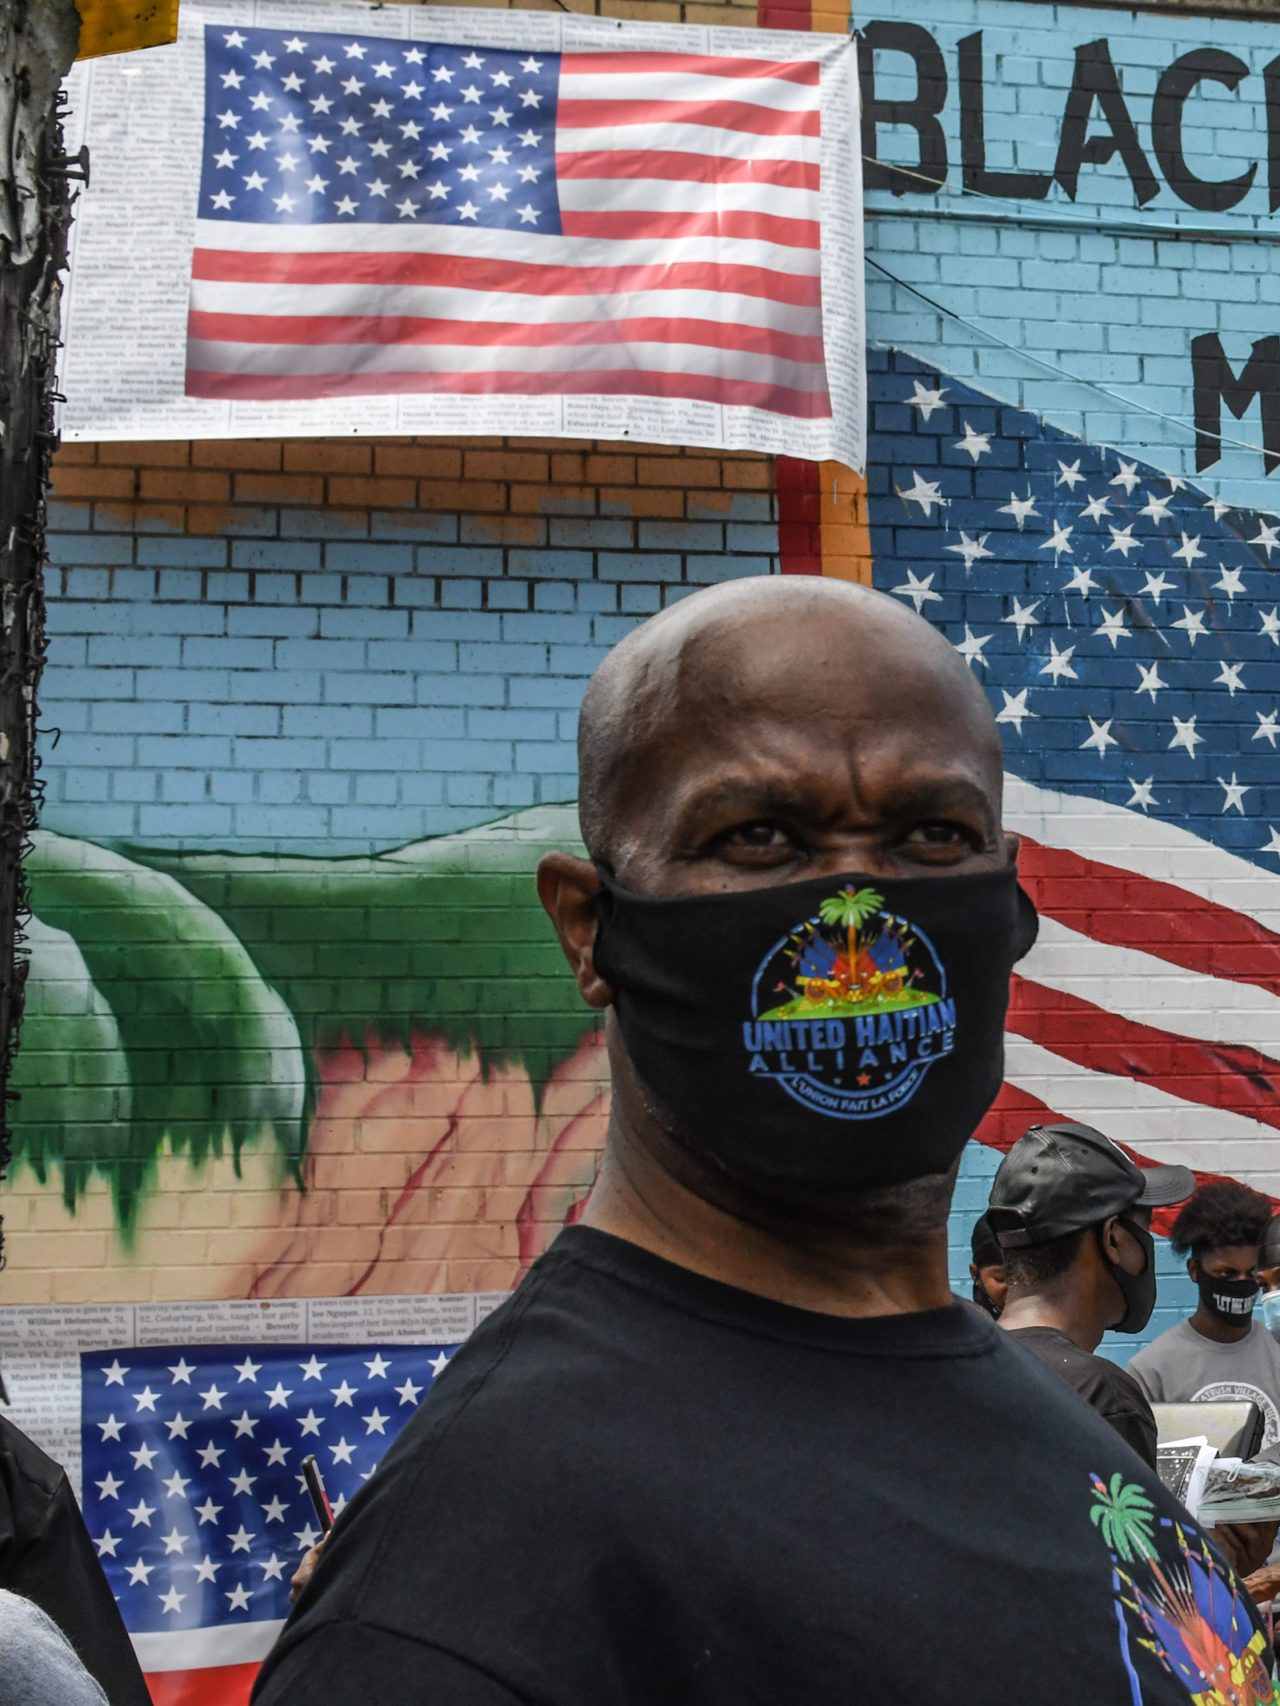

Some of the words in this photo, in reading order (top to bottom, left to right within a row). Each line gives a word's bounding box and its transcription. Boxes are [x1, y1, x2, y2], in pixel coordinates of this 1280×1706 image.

[742, 1019, 846, 1052] UNITED
[855, 998, 957, 1048] HAITIAN
[748, 1031, 955, 1073] ALLIANCE
[791, 1076, 839, 1110] L'UNION
[841, 1099, 870, 1112] FAIT
[870, 1097, 889, 1110] LA
[1196, 1385, 1232, 1402] ATBUSH
[1233, 1385, 1267, 1409] VILLAGE
